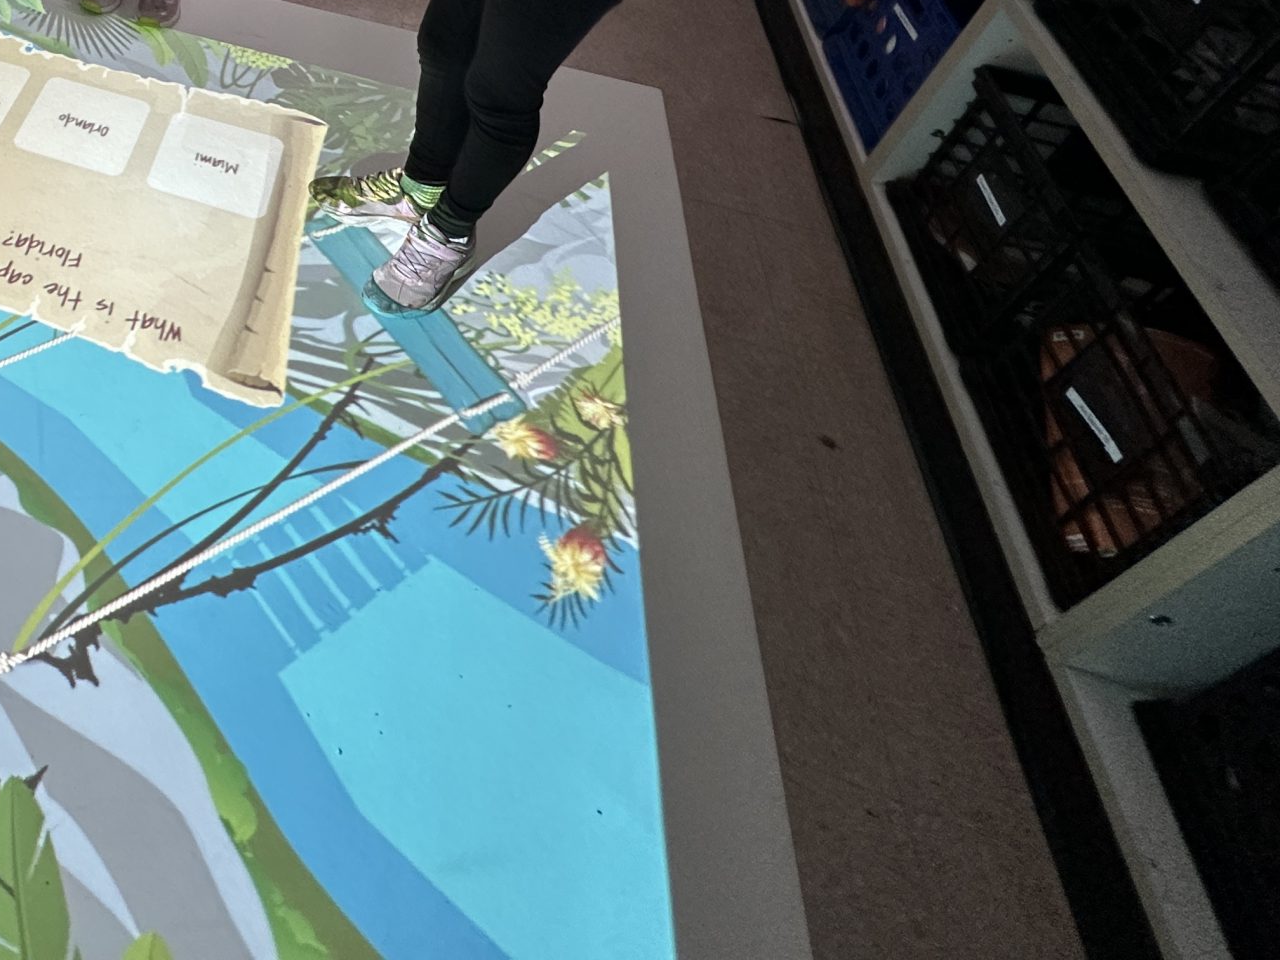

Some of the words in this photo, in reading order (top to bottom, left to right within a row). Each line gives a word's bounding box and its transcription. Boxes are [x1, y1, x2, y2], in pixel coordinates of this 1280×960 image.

[58, 112, 110, 137] Orlando
[194, 151, 239, 175] Miami
[1, 230, 83, 269] Florida?
[43, 281, 83, 312] the
[96, 299, 115, 324] is
[125, 309, 183, 342] What
